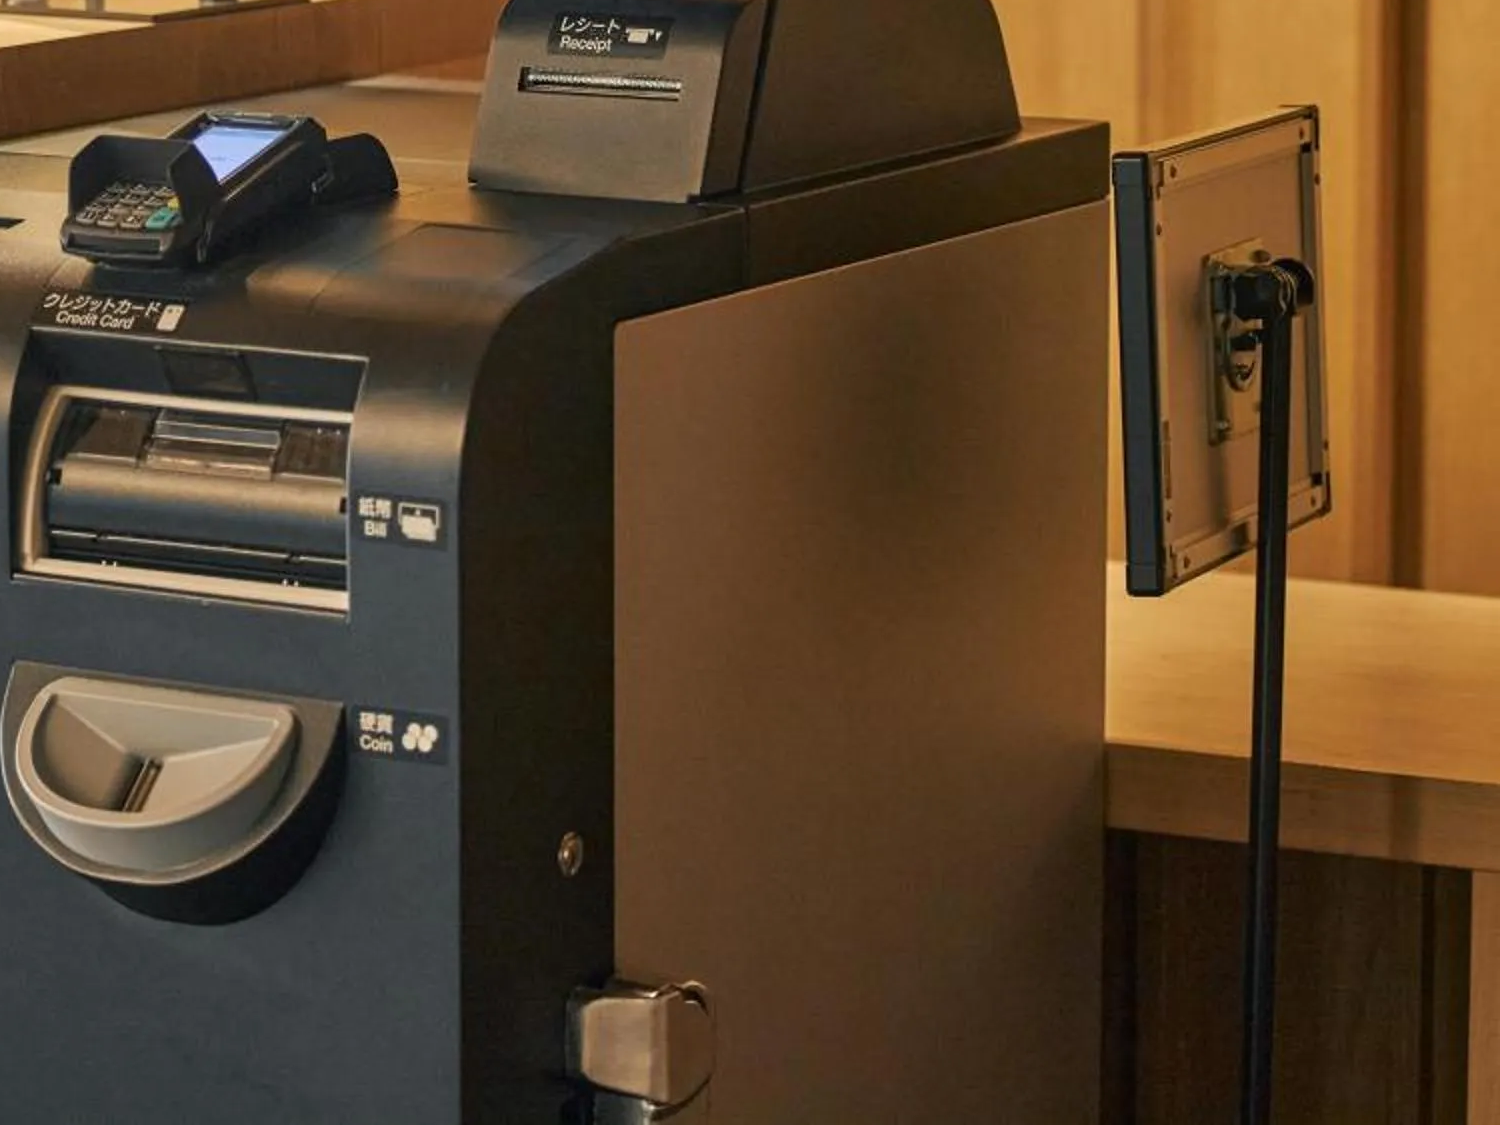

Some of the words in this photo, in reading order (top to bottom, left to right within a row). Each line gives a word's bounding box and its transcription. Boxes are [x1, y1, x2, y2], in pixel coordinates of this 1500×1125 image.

[560, 16, 620, 34] レシート
[559, 34, 613, 54] Receipt
[43, 292, 162, 319] クレジットカード
[55, 310, 99, 327] Credit
[100, 314, 135, 330] Card
[364, 520, 388, 538] Bill
[359, 734, 393, 754] Coin
